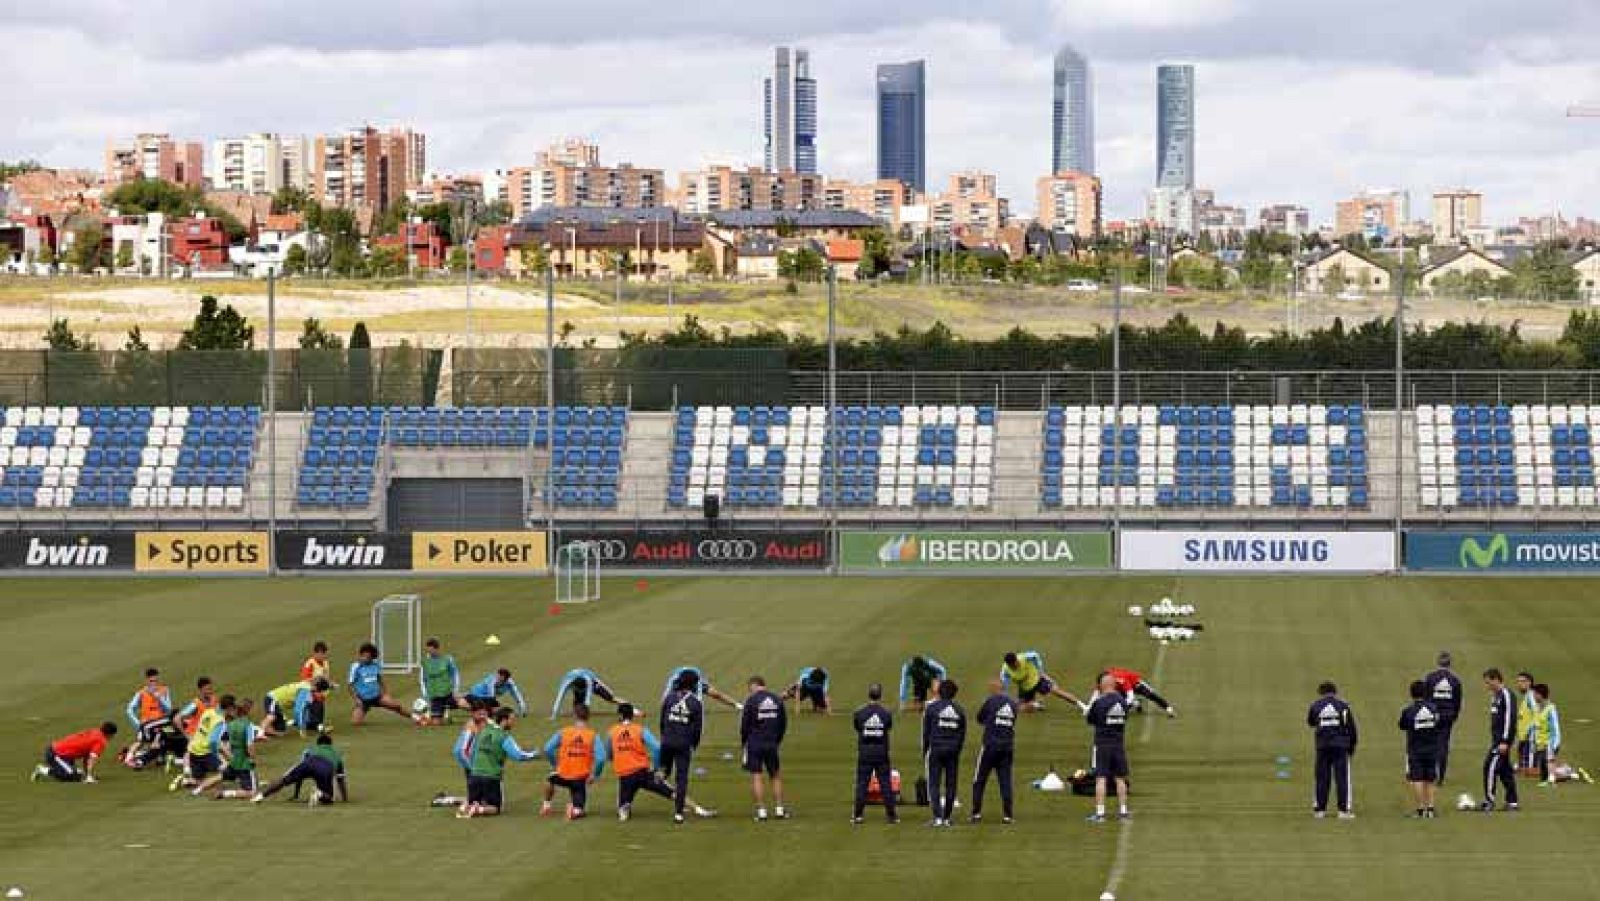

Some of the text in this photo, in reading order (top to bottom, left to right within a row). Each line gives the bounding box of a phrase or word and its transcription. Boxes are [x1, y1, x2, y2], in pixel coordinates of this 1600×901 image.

[26, 537, 259, 569] bwin Sports
[303, 536, 532, 566] bwin Poker
[633, 541, 823, 560] Audi Audi
[920, 539, 1074, 562] IBERDROLA
[1184, 539, 1329, 562] SAMSUNG
